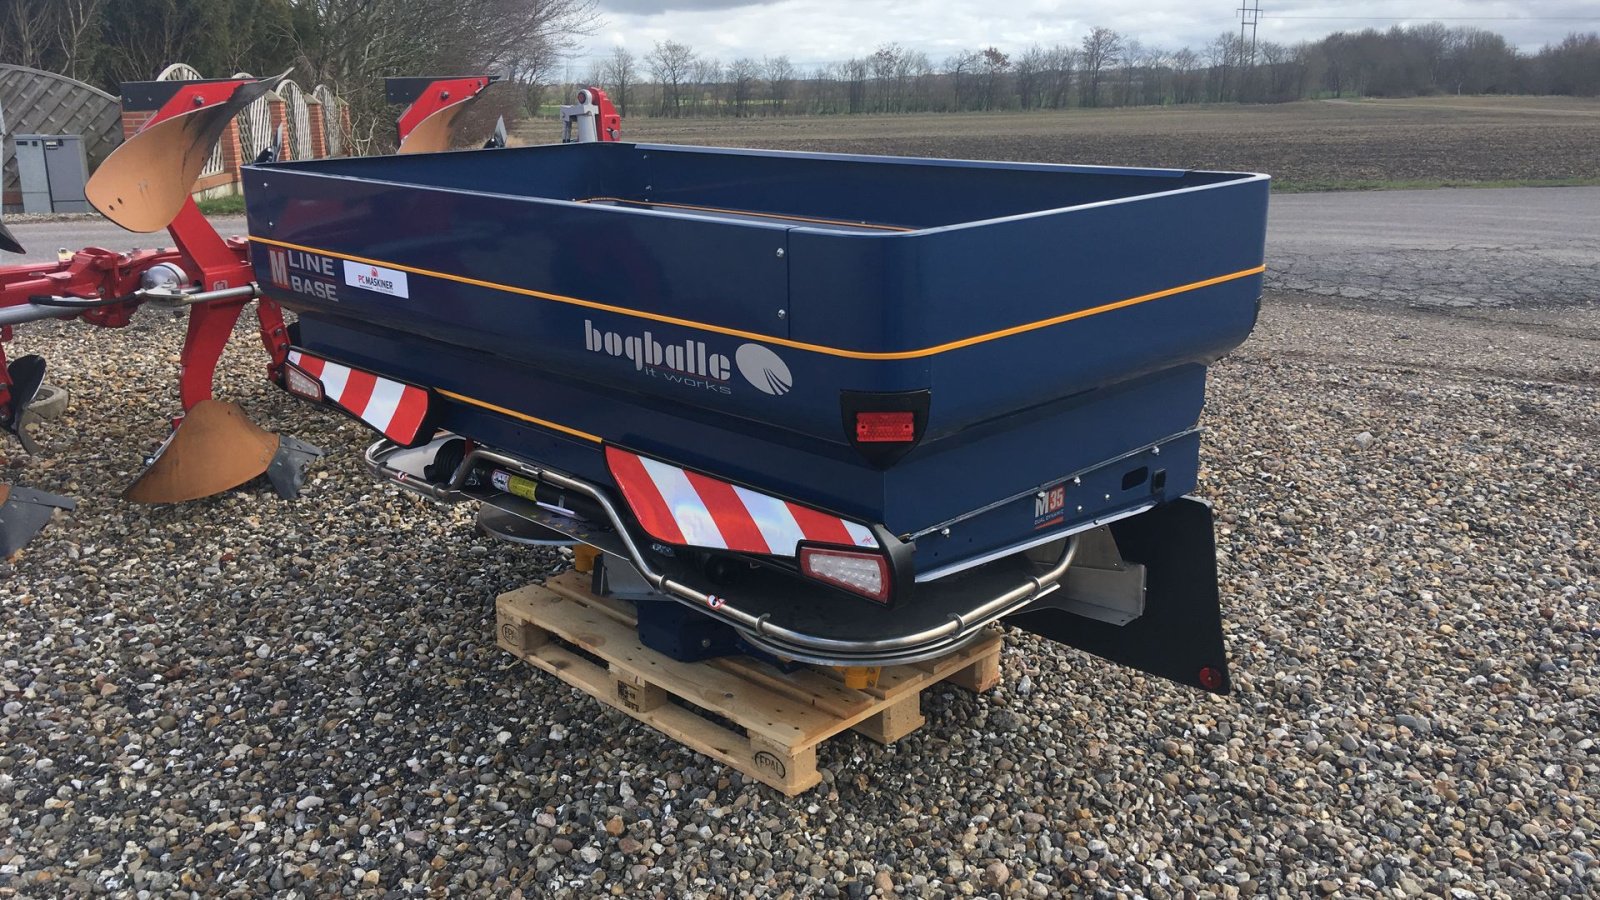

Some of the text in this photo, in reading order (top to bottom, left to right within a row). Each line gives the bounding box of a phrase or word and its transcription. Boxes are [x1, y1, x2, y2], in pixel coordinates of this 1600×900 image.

[269, 250, 335, 286] M LINE
[291, 275, 339, 302] BASE
[365, 276, 394, 290] MASKINER
[644, 366, 732, 395] it works
